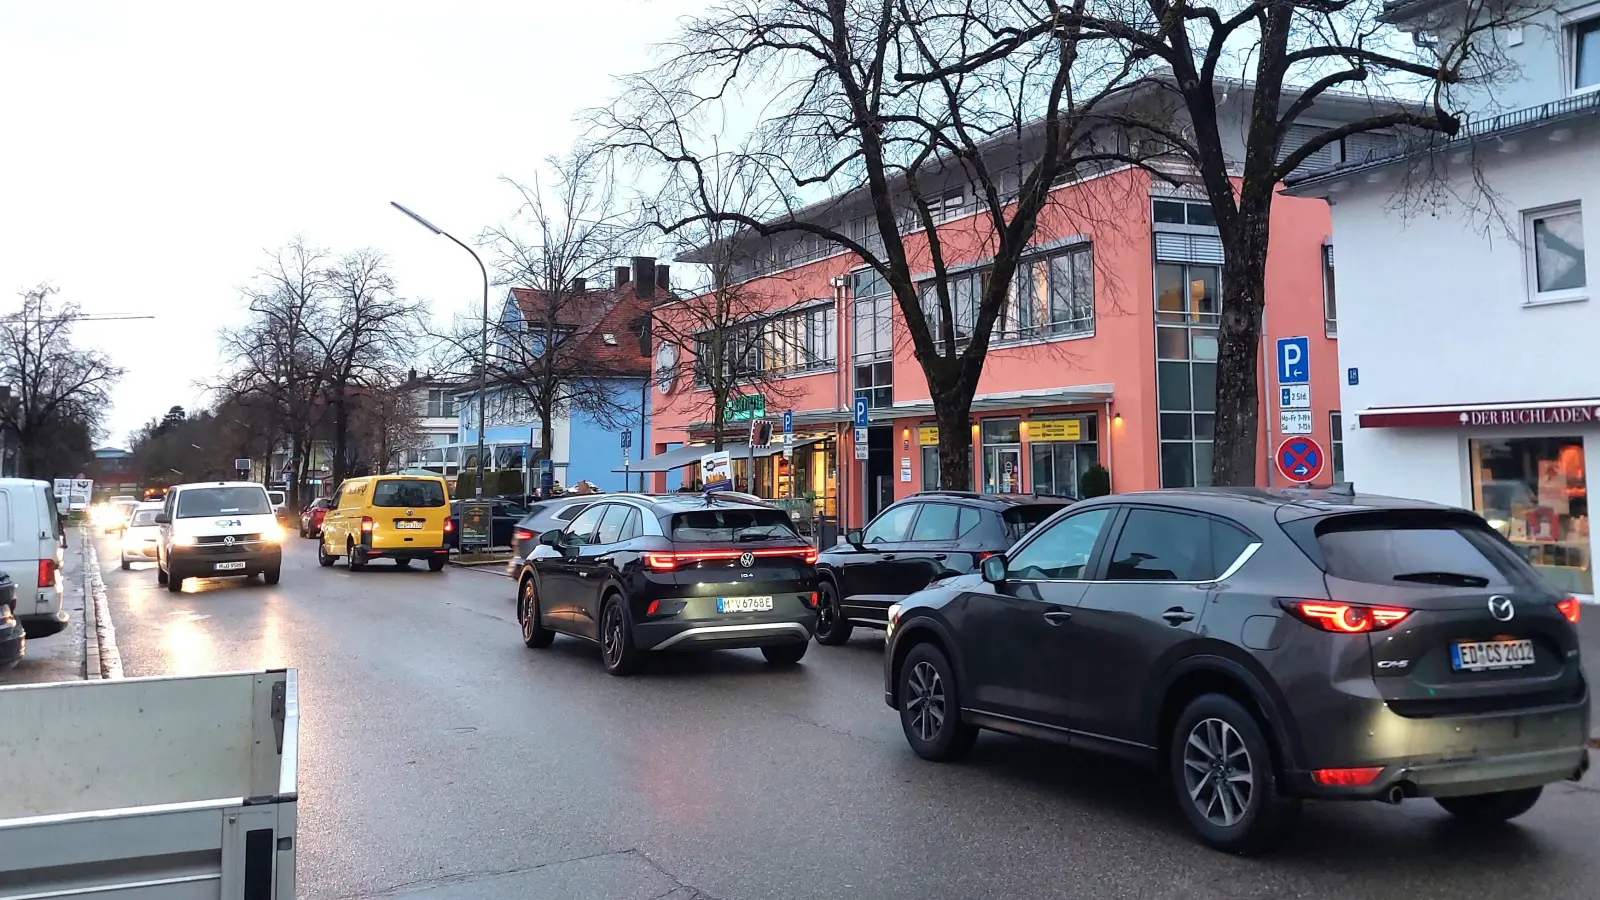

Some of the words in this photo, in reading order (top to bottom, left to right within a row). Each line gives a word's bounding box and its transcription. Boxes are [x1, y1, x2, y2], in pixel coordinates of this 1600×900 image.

[1284, 343, 1301, 377] P
[1349, 369, 1357, 380] 18
[1291, 393, 1295, 401] 2
[1296, 392, 1308, 401] Std.
[857, 401, 865, 423] P
[1471, 411, 1499, 425] DER
[1501, 406, 1592, 424] BUCHLADEN
[785, 414, 791, 431] P
[1461, 645, 1477, 664] ED
[1486, 644, 1502, 662] CS
[1504, 642, 1532, 661] 2012
